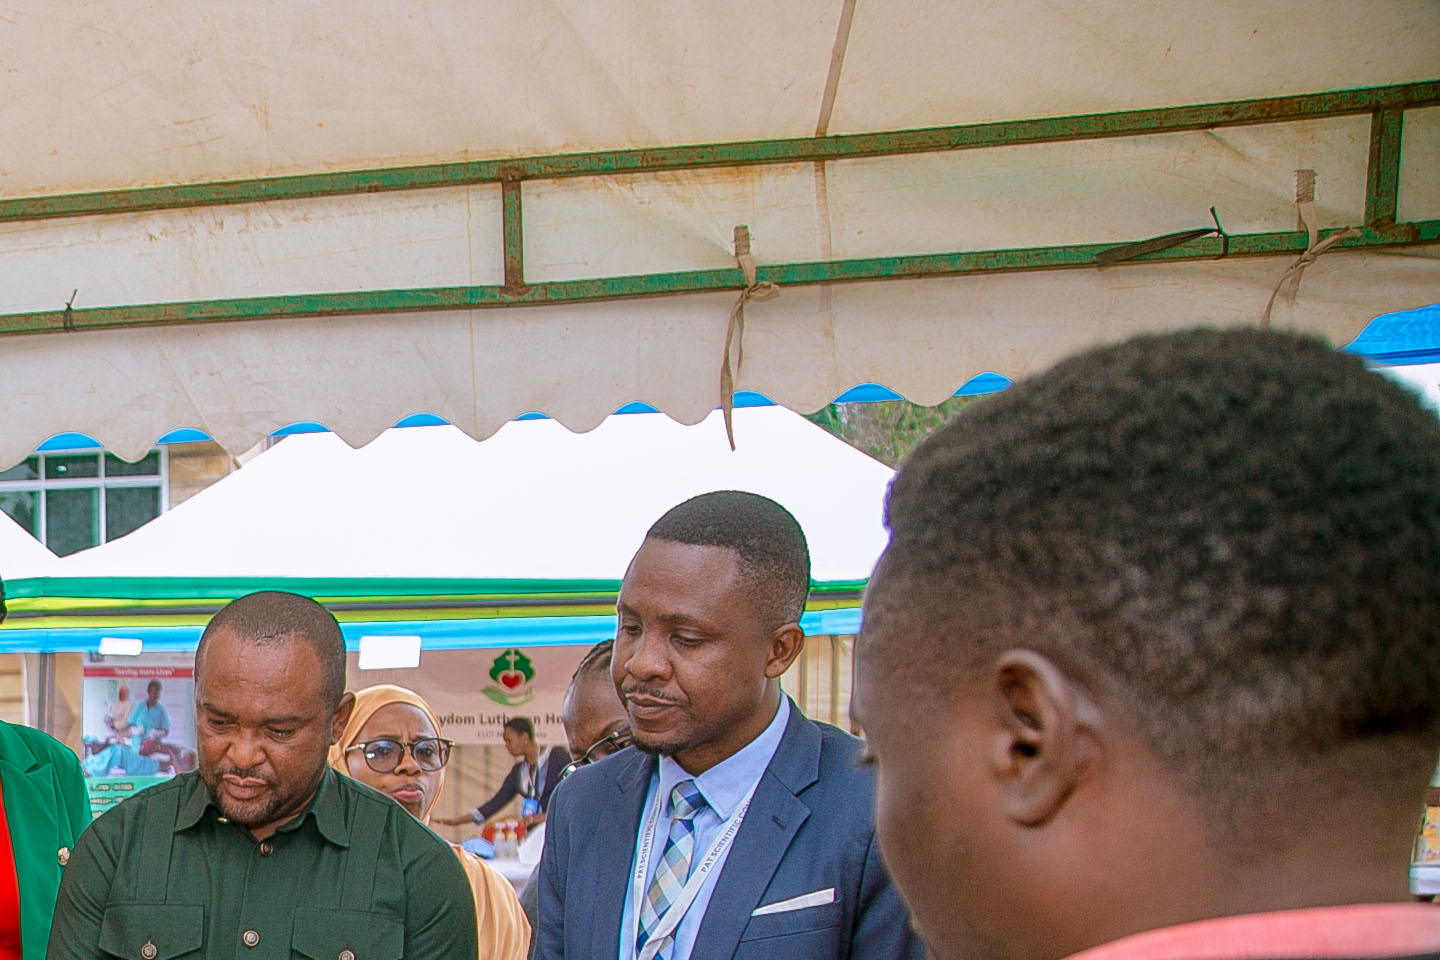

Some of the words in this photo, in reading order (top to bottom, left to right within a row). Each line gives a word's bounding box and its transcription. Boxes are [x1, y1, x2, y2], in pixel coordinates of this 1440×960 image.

[439, 713, 475, 727] ydom
[480, 713, 541, 724] Luthn
[701, 857, 713, 873] PAT
[712, 819, 739, 856] SCIENTIFIC
